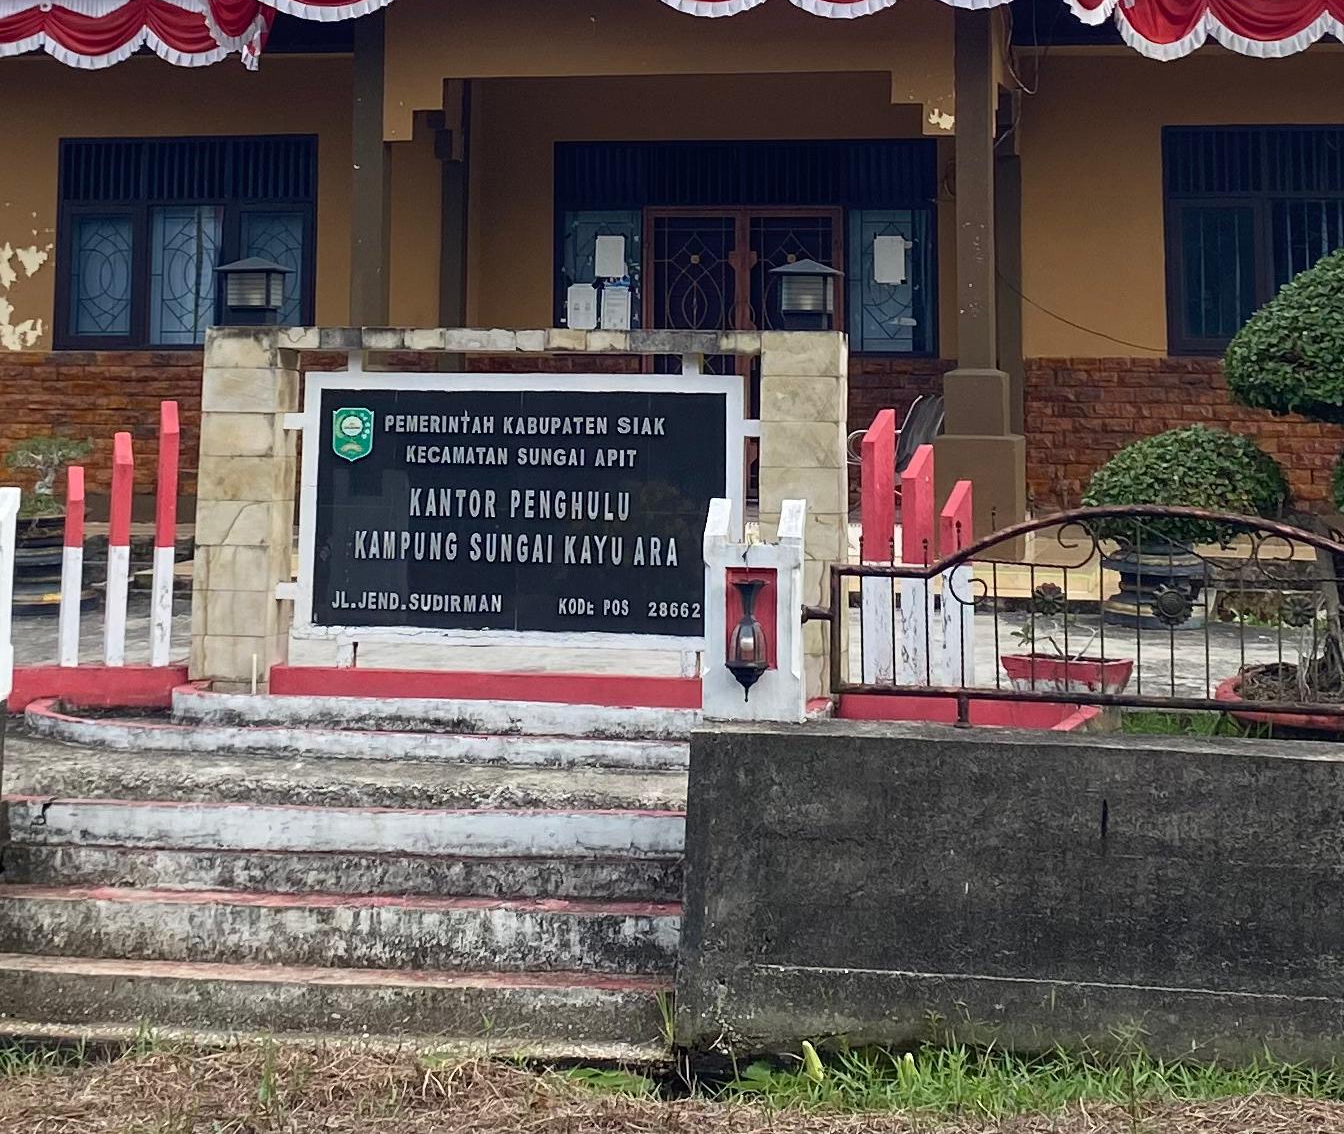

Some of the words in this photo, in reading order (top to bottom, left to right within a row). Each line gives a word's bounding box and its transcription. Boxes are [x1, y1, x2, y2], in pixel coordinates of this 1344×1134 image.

[384, 410, 495, 435] PEMERINTAH
[503, 416, 608, 435] KABUPATEN
[617, 417, 666, 436] SIAK
[405, 446, 508, 465] KECAMATAN
[517, 448, 586, 466] SUNGAI
[594, 449, 637, 467] APIT
[409, 488, 496, 518] KANTOR
[510, 489, 631, 521] PENGHULU
[354, 530, 458, 560] KAMPUNG
[469, 532, 554, 564] SUNGAI
[563, 535, 623, 566] KAYU
[633, 537, 679, 567] ARA
[603, 599, 630, 616] POS
[647, 601, 702, 618] 28662
